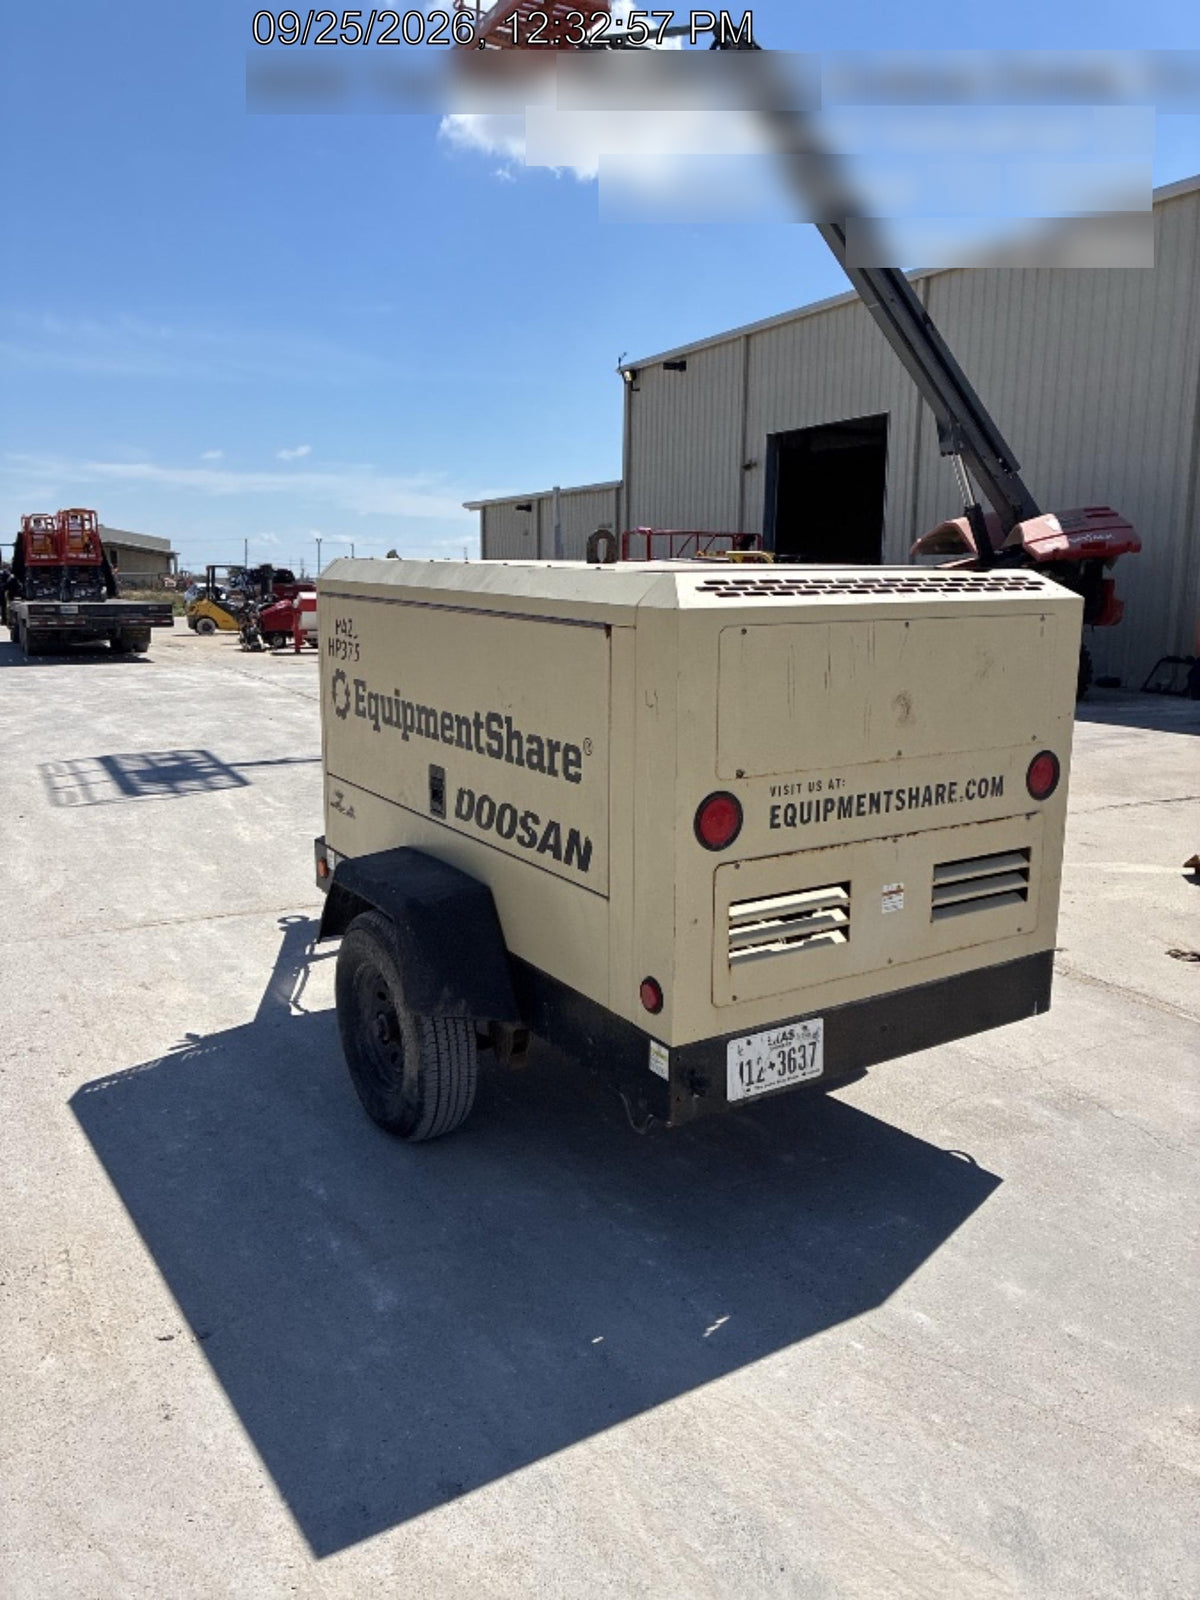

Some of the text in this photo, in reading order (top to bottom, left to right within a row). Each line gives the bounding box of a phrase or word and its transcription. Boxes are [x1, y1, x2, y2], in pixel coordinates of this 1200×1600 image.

[328, 637, 360, 662] HP375
[769, 775, 1005, 830] EQUIPMENTSHARE.COM
[770, 778, 846, 797] VISIT US AT:
[455, 787, 593, 873] DOOSAN
